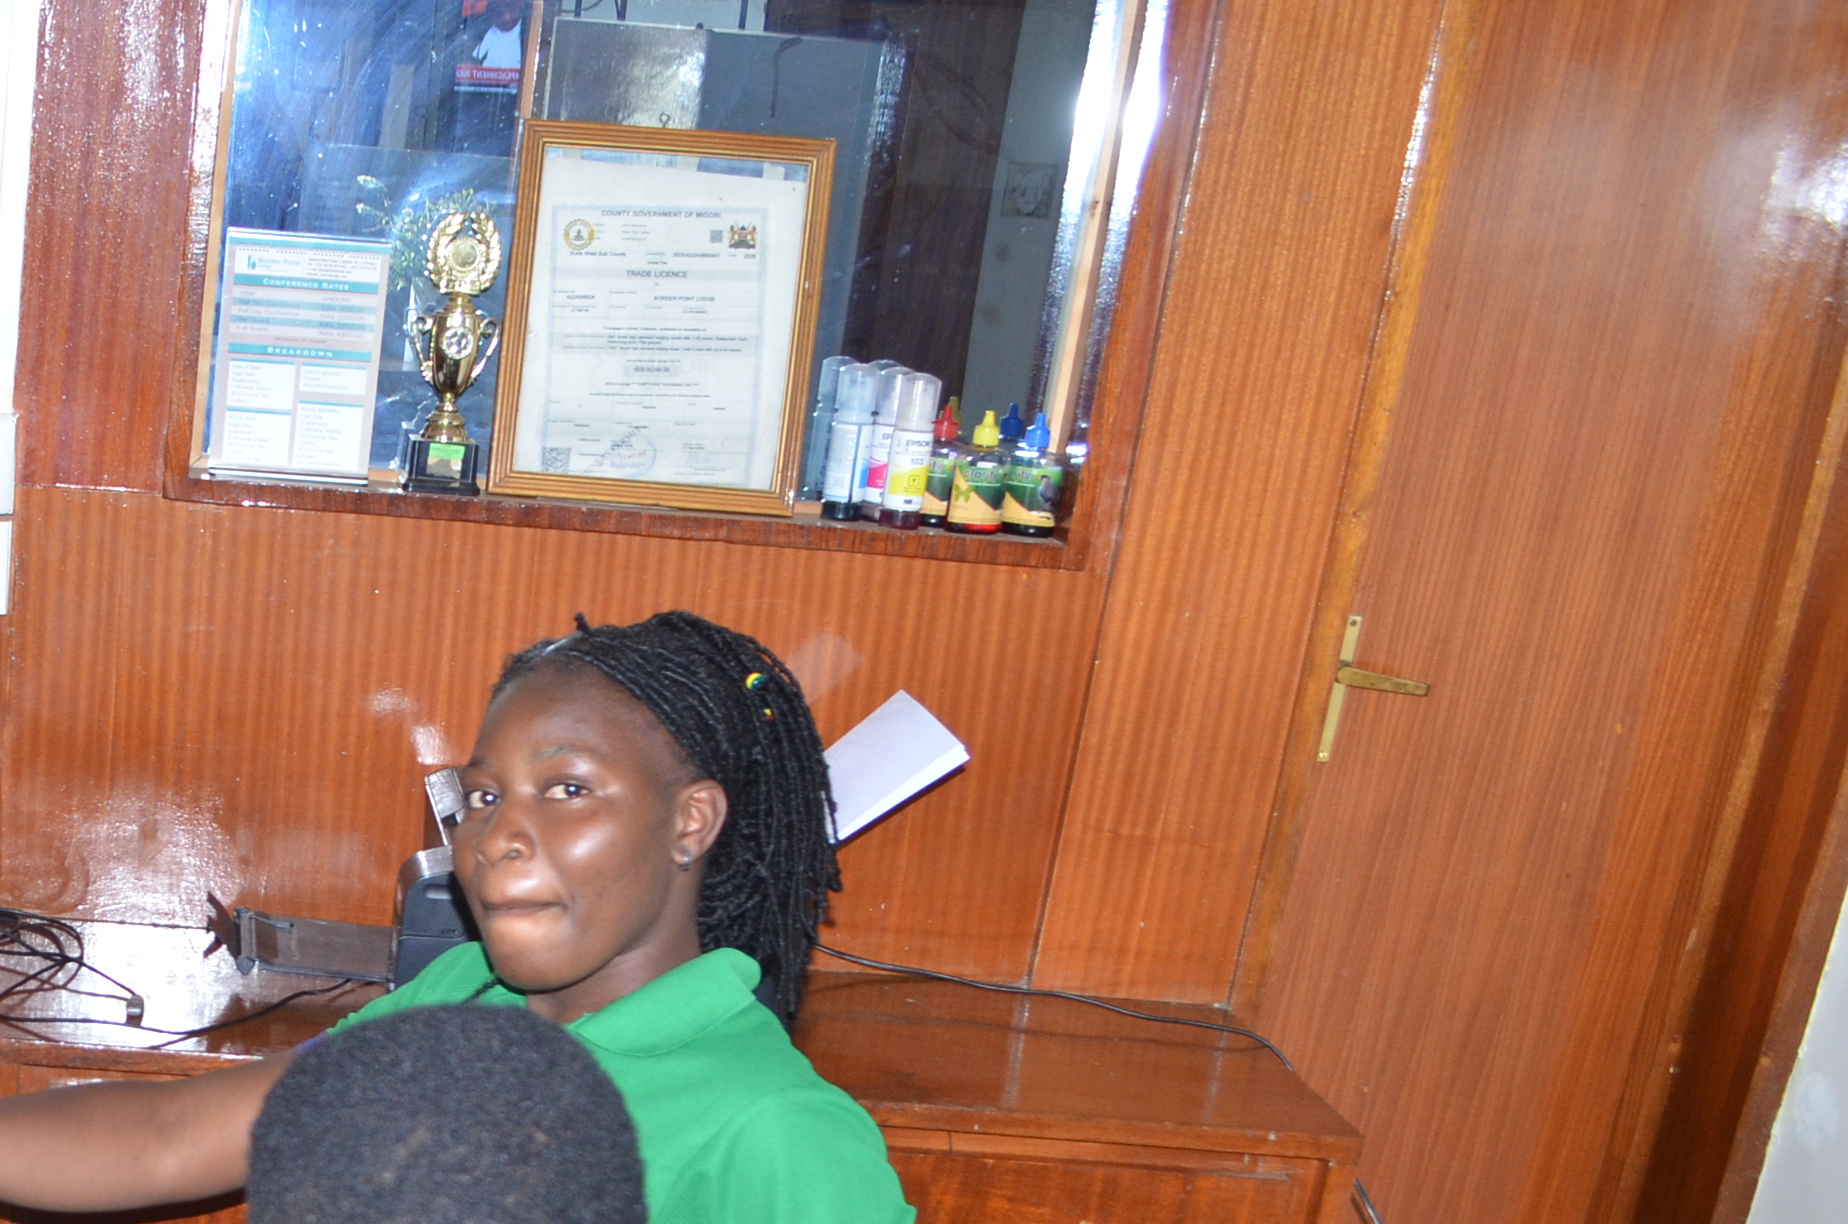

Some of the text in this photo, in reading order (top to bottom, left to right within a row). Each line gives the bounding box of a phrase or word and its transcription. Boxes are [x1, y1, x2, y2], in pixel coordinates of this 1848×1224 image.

[601, 210, 631, 218] COUNTY
[633, 210, 682, 219] GOVERNMENT
[695, 211, 722, 219] MIGORI
[626, 269, 688, 279] TRADE LICENCE
[910, 457, 924, 466] 103
